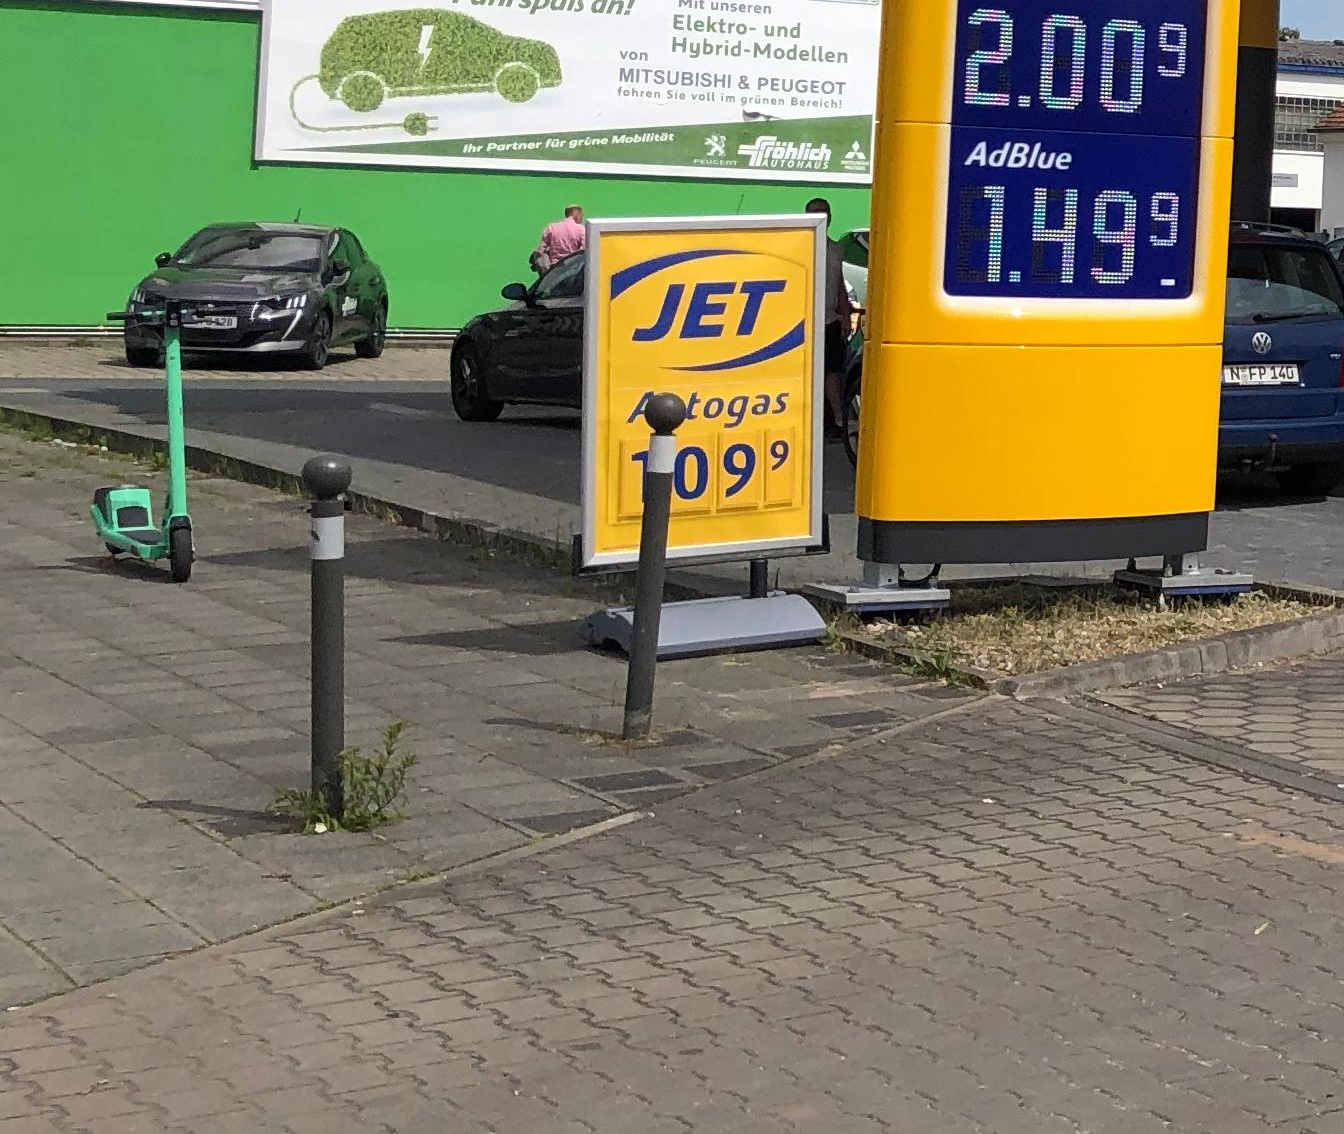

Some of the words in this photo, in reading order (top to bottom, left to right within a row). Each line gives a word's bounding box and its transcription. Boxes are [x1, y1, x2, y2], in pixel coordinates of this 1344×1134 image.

[710, 1, 772, 14] unseren
[673, 14, 757, 36] Elektro-
[763, 22, 801, 39] und
[619, 50, 649, 62] von
[671, 36, 849, 64] Hybrid-Modellen
[618, 67, 732, 90] MITSUBISHI
[737, 75, 750, 90] &
[757, 77, 847, 96] PEUGEOT
[617, 86, 661, 99] fahren
[666, 89, 686, 101] Sie
[691, 91, 716, 103] voll
[720, 92, 736, 104] im
[740, 94, 785, 107] grünen
[790, 97, 843, 109] Bereich!
[462, 143, 483, 154] Ihr
[486, 139, 542, 152] Partner
[545, 137, 567, 149] für
[569, 136, 608, 150] grüne
[611, 132, 675, 145] Mobilität
[762, 159, 829, 170] AUTOHAUS
[964, 141, 1073, 171] AdBlue
[632, 279, 787, 341] JET
[626, 391, 790, 428] Atogas
